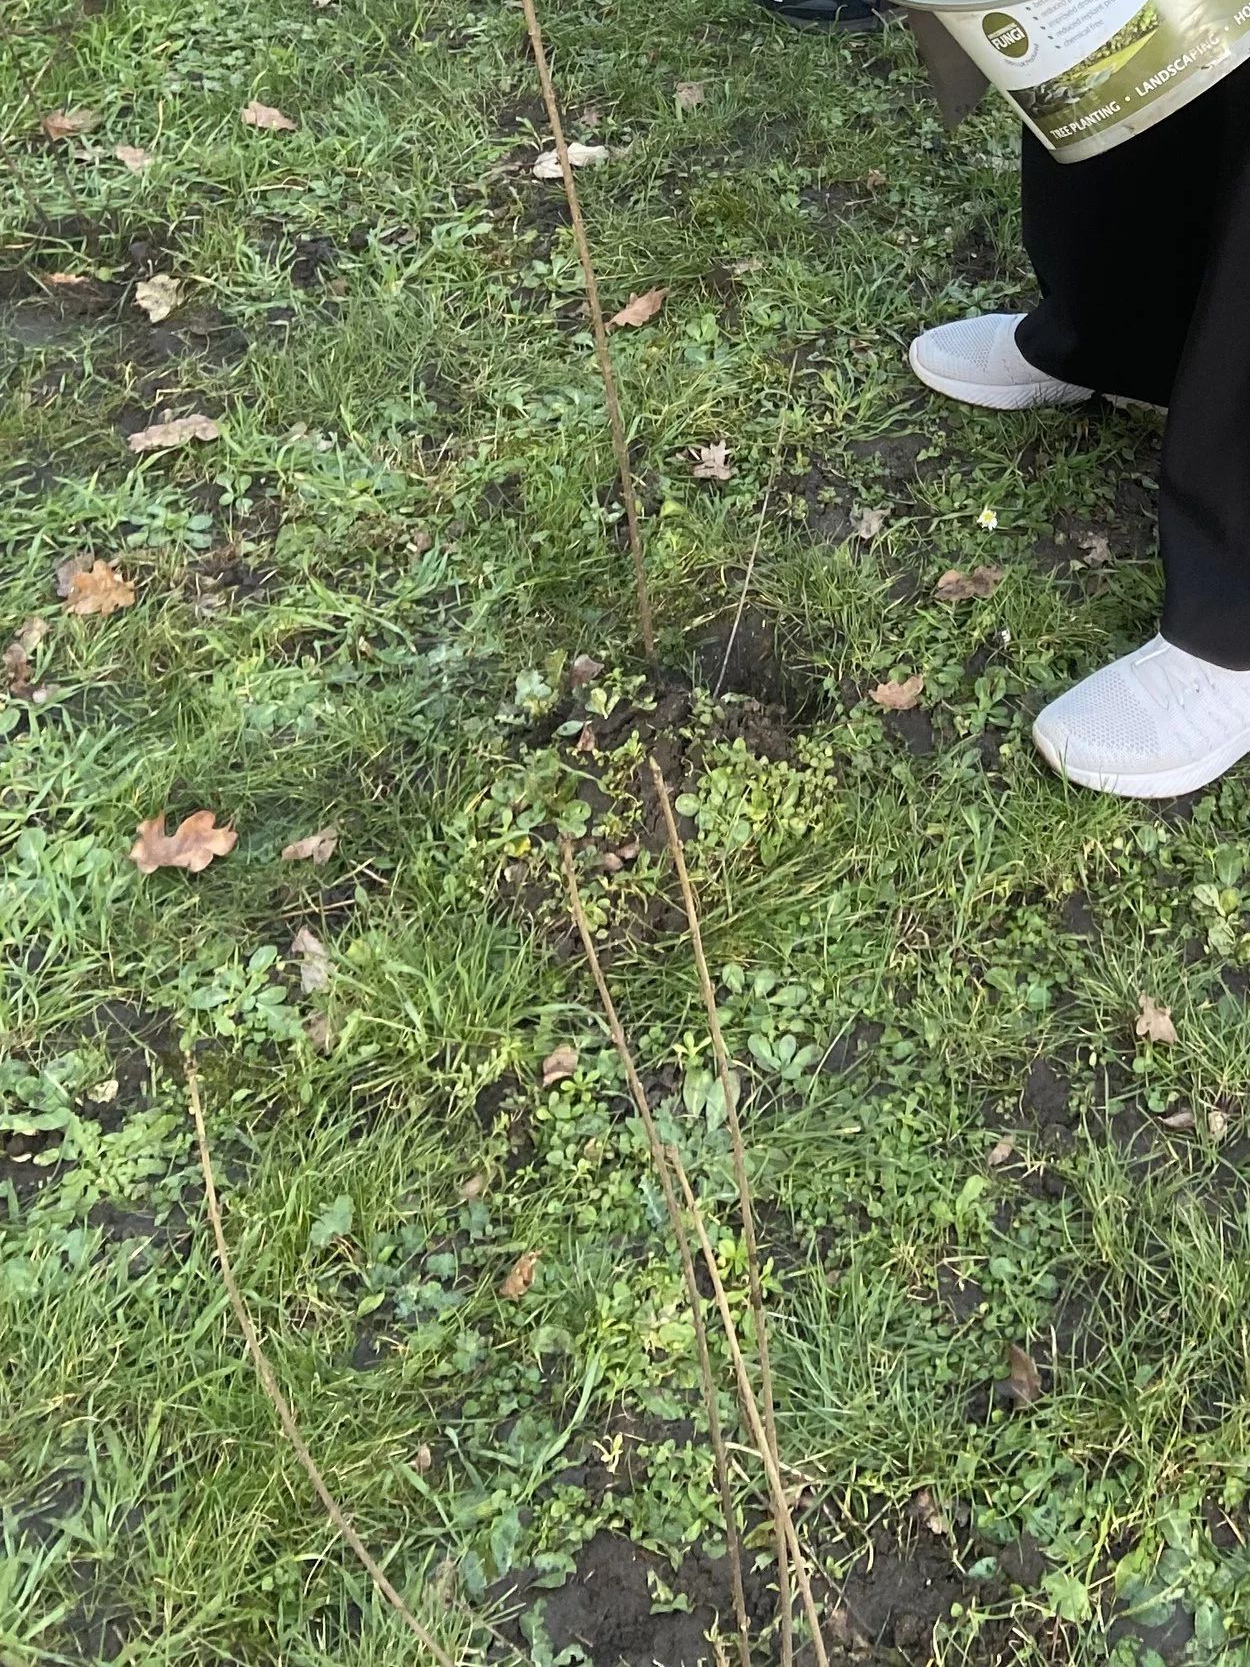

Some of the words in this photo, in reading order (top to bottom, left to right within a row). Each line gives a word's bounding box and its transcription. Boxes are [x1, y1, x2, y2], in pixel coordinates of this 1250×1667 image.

[991, 27, 1026, 50] FUNGI
[1050, 125, 1073, 140] TREE
[1070, 100, 1121, 132] PLANTING
[1135, 32, 1220, 97] LANDSCAPING
